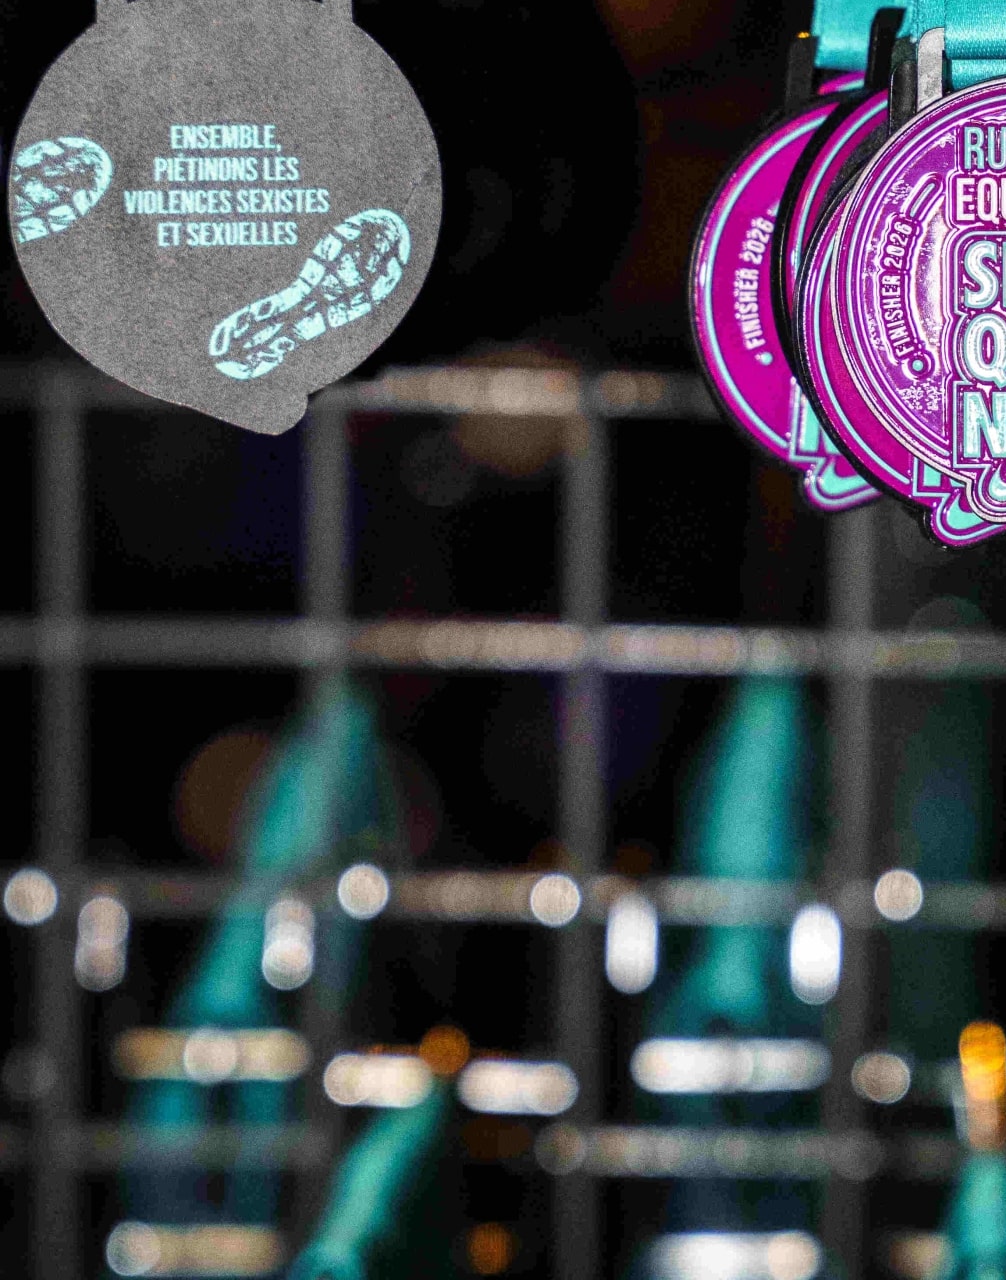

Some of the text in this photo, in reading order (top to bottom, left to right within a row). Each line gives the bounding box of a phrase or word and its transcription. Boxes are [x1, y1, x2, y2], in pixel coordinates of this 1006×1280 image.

[170, 124, 282, 153] ENSEMBLE,
[153, 153, 300, 182] PIÉTINONS LES
[124, 188, 331, 214] VIOLENCES SEXISTES
[157, 221, 299, 247] ET SEXUELLES
[739, 217, 775, 350] FINISHER 2026
[881, 221, 915, 357] FINISHER 2026
